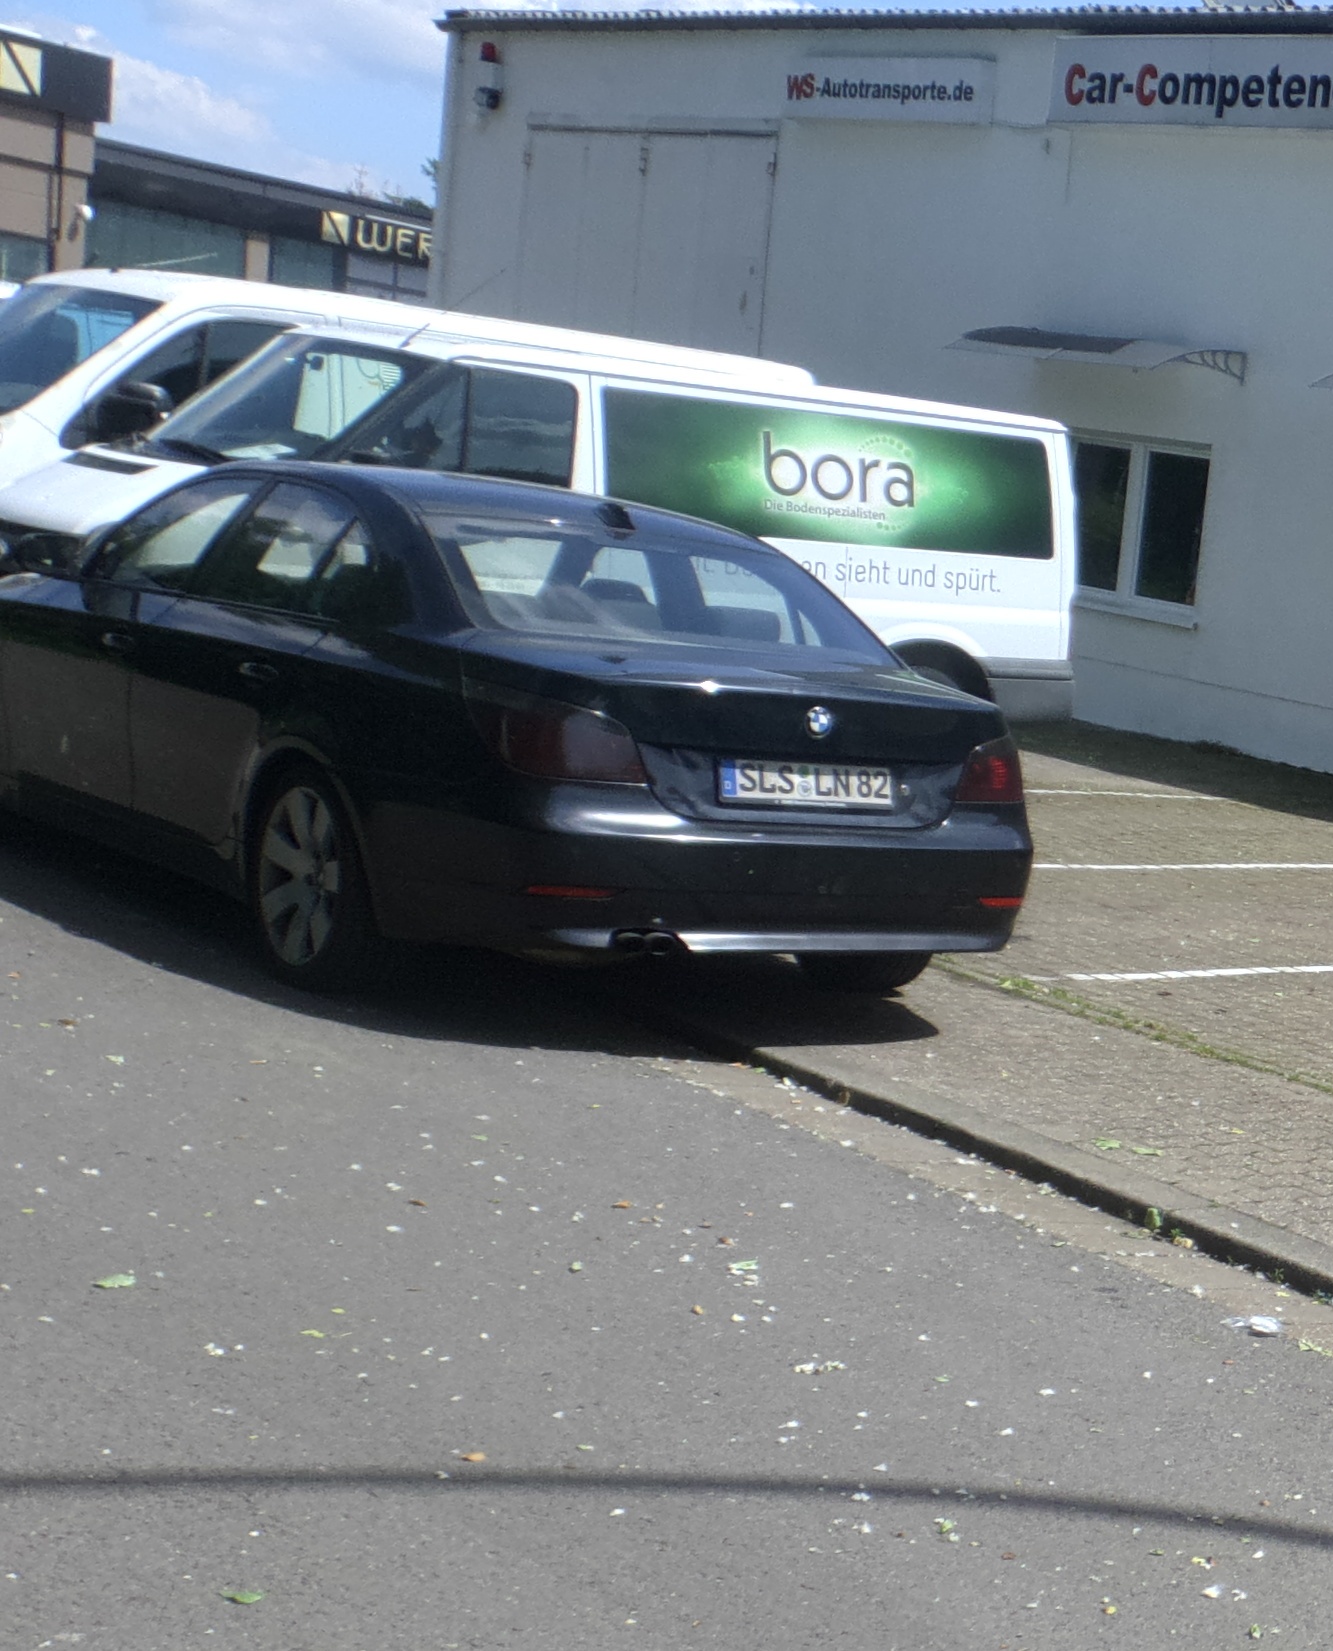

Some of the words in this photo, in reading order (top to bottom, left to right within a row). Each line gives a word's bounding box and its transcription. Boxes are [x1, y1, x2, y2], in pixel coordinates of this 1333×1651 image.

[786, 73, 975, 104] WS-Autotransporte.de
[763, 430, 915, 508] bora
[764, 499, 783, 511] Die
[786, 501, 886, 521] Bodenspezialisten
[835, 557, 890, 584] sieht
[898, 564, 936, 588] und
[943, 567, 1001, 596] spürt.
[739, 763, 795, 794] SLS
[814, 767, 850, 797] LN
[857, 769, 890, 800] 82
